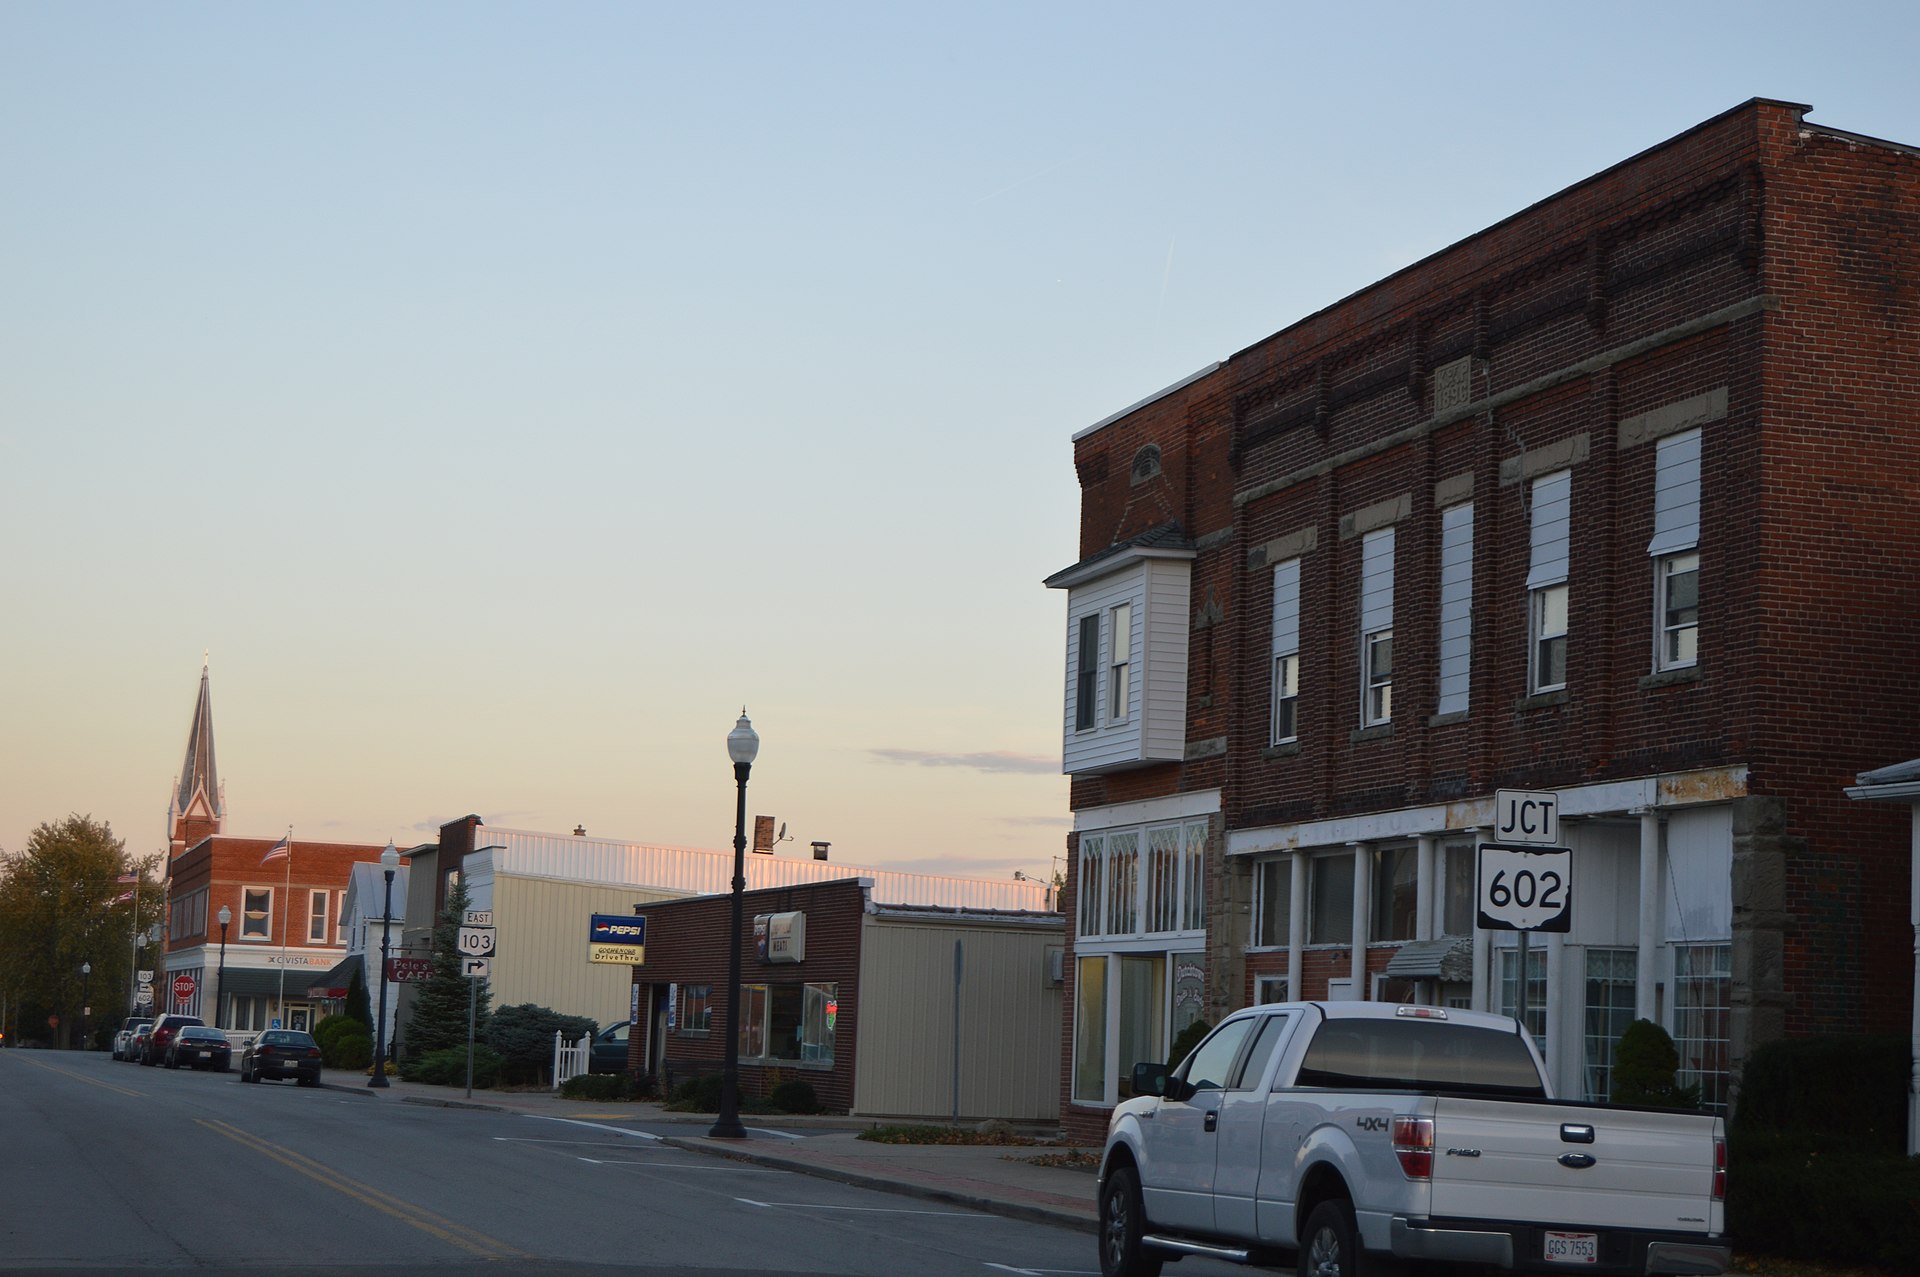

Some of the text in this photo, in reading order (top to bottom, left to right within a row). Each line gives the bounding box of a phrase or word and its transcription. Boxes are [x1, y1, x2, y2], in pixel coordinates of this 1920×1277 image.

[1438, 384, 1468, 409] 1896
[1501, 800, 1554, 834] JCT
[1490, 869, 1562, 908] 602
[467, 912, 489, 923] EAST
[609, 925, 641, 935] PEPSI
[463, 934, 490, 949] 103
[174, 982, 195, 992] STOP
[1548, 1239, 1594, 1256] GGS 7553
